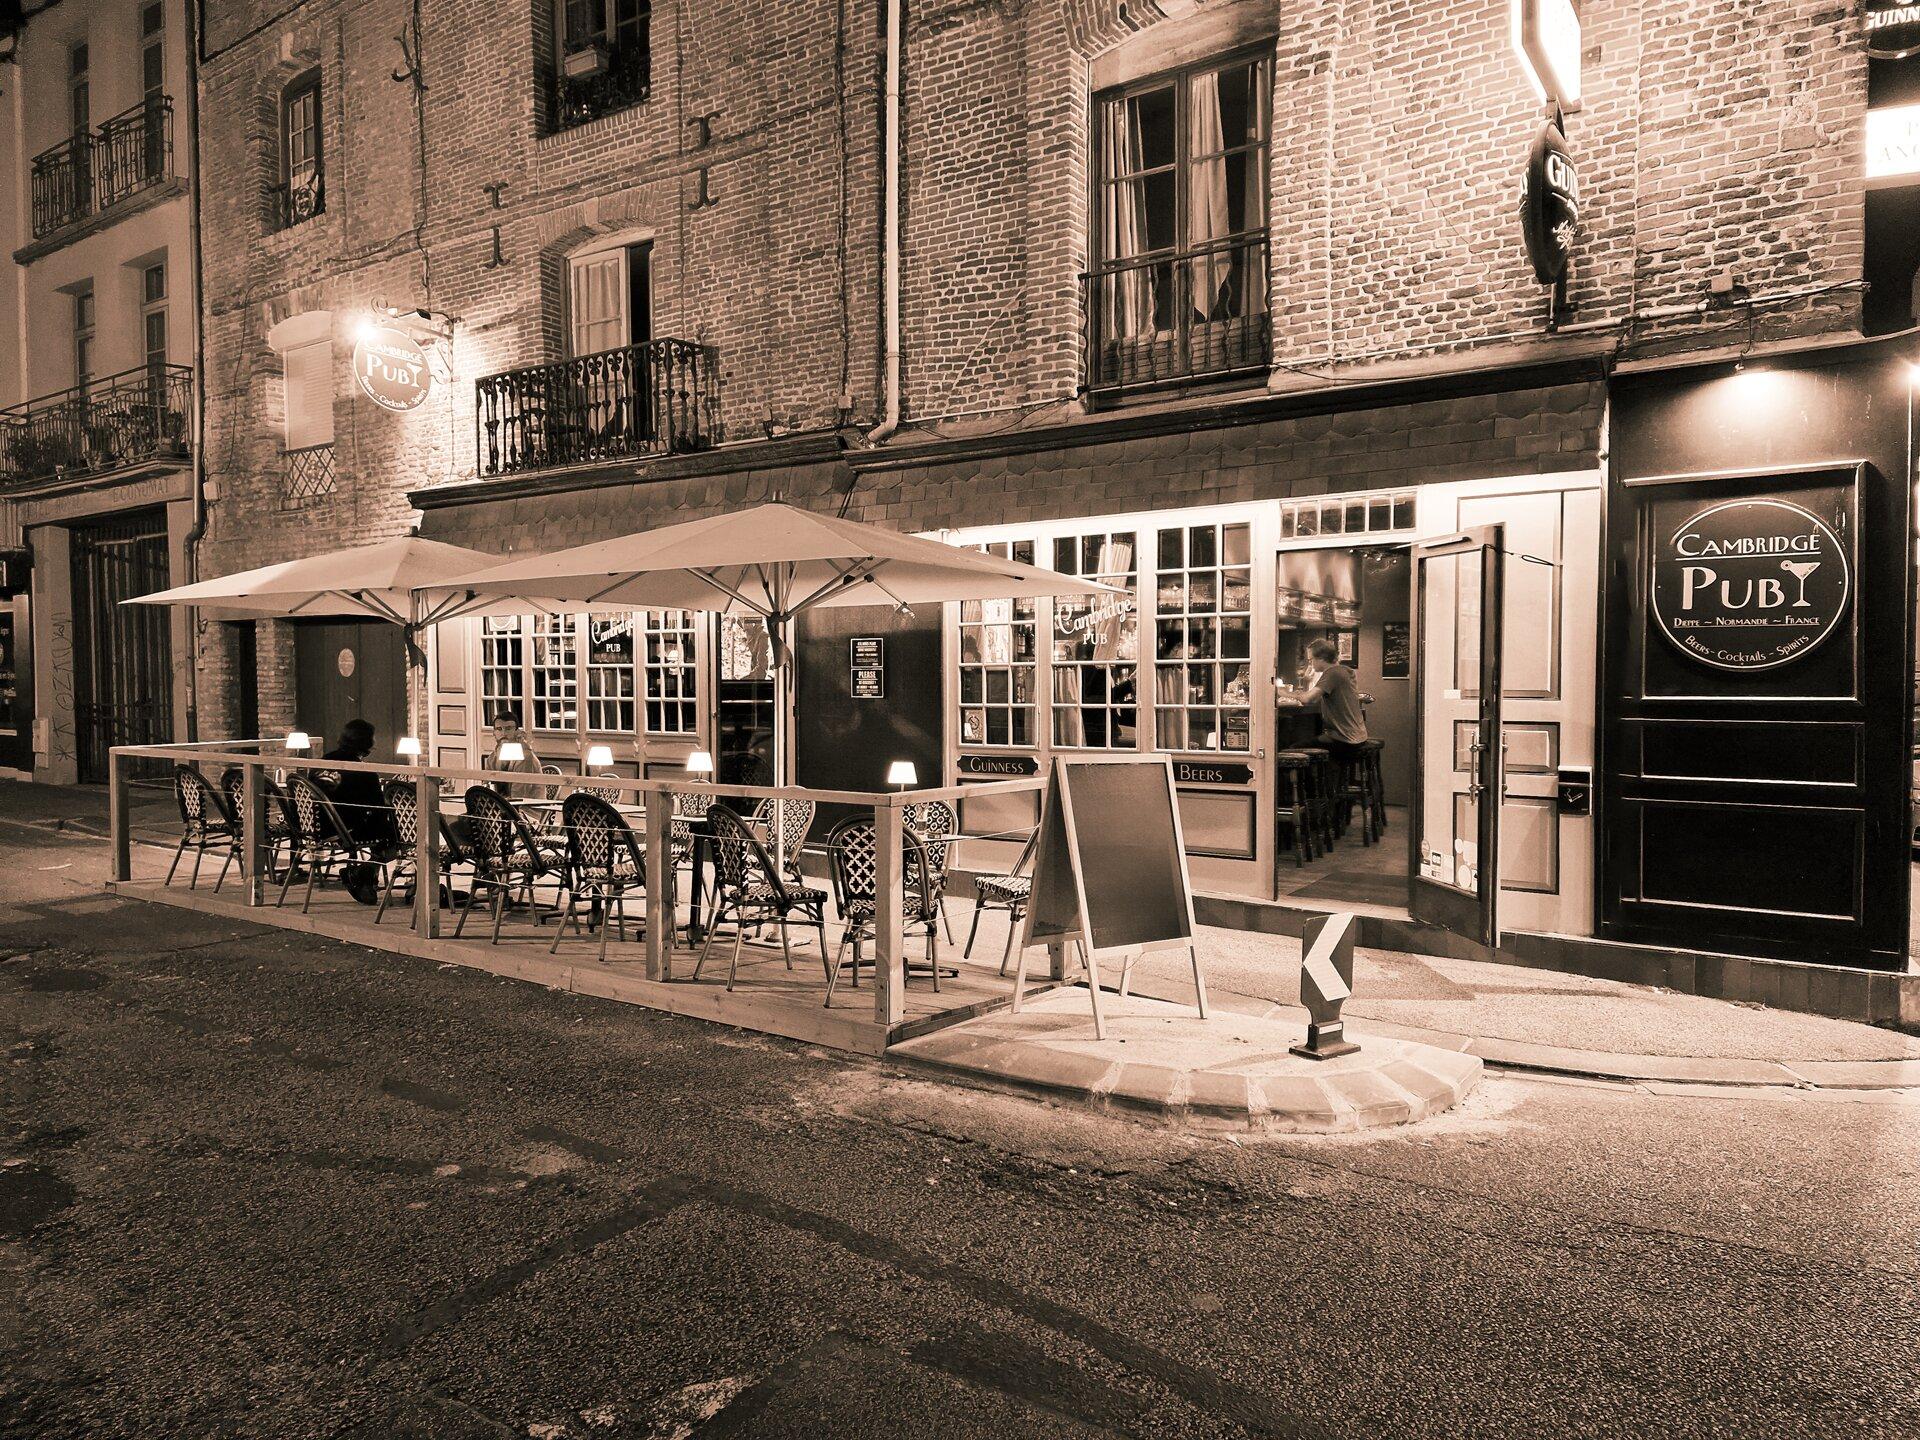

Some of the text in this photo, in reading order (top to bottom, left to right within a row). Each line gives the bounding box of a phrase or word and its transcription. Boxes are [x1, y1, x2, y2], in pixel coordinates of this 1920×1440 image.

[366, 353, 410, 385] PUB
[1677, 533, 1821, 557] CAMBRIDGE
[1682, 566, 1785, 610] PUB
[1057, 594, 1133, 636] Cambridge
[606, 643, 621, 653] PUB
[1082, 632, 1108, 645] PUB
[970, 757, 1024, 774] GUINNESS
[1180, 764, 1223, 782] BEERS
